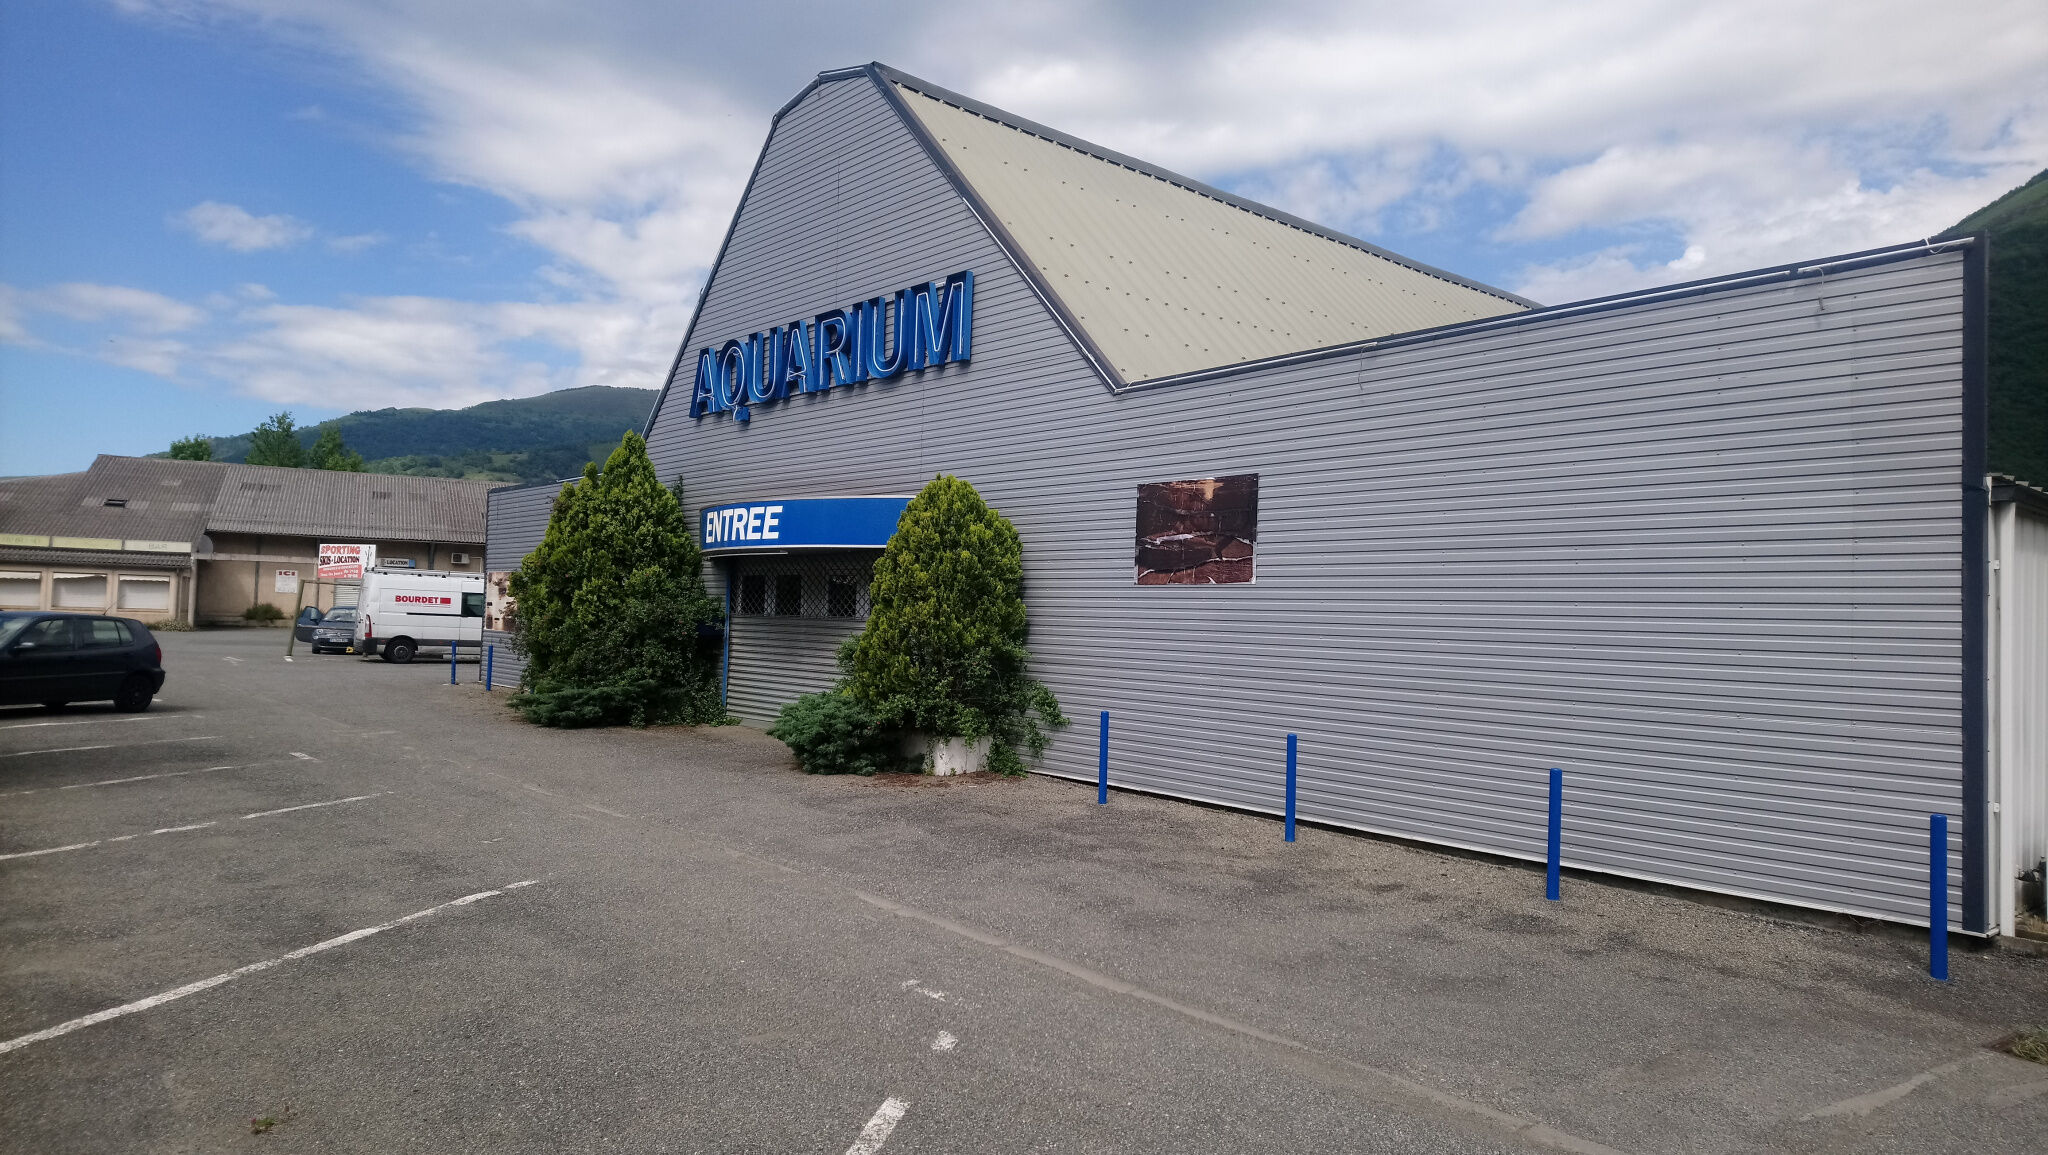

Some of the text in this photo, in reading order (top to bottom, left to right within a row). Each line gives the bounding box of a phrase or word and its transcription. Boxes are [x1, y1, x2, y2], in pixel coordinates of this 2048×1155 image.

[689, 269, 974, 422] AQUARIUM
[705, 505, 783, 544] ENTREE
[321, 545, 361, 555] SPORTING
[333, 555, 360, 564] LOCATION
[395, 595, 439, 604] BOURDET
